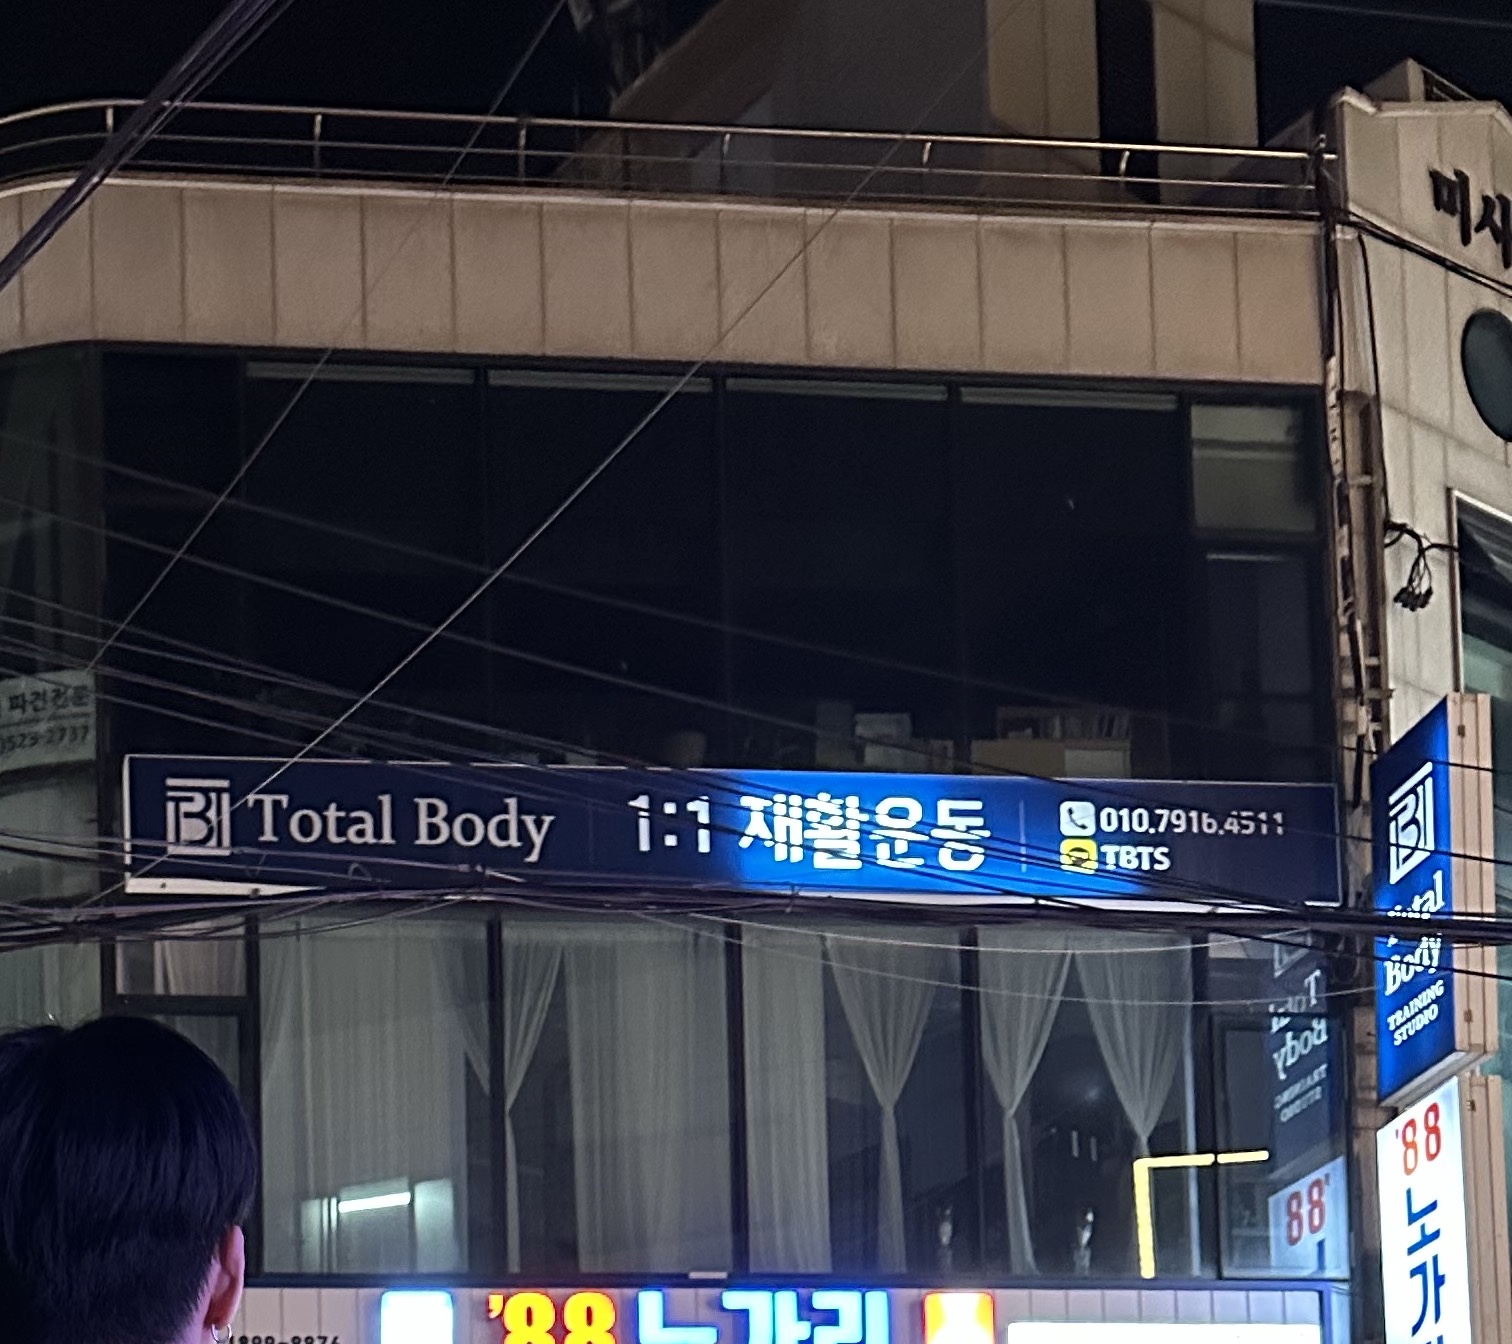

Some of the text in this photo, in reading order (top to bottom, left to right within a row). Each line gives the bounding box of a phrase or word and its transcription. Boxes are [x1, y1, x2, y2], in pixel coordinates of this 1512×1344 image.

[247, 793, 556, 863] Total Body
[628, 792, 991, 871] 1:1 재활운동
[1099, 844, 1172, 871] TBTS
[1387, 979, 1445, 1034] TRAINING
[1393, 1003, 1439, 1047] STUDIO
